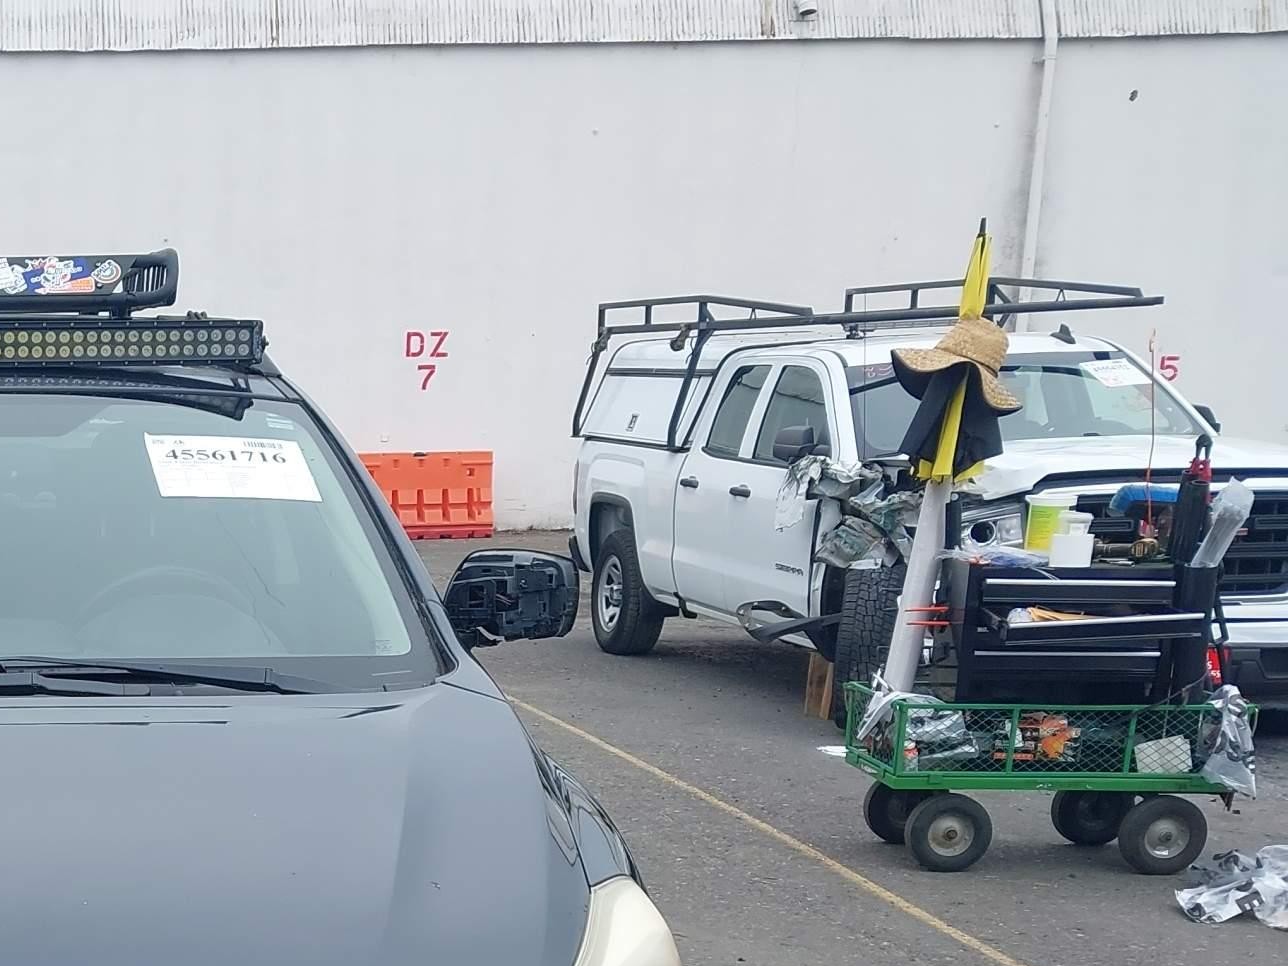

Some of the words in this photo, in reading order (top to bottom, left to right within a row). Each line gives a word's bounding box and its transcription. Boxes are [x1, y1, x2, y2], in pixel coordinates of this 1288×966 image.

[405, 331, 449, 358] DZ
[417, 364, 436, 391] 7
[1159, 356, 1181, 381] 5
[165, 449, 287, 464] 45561716
